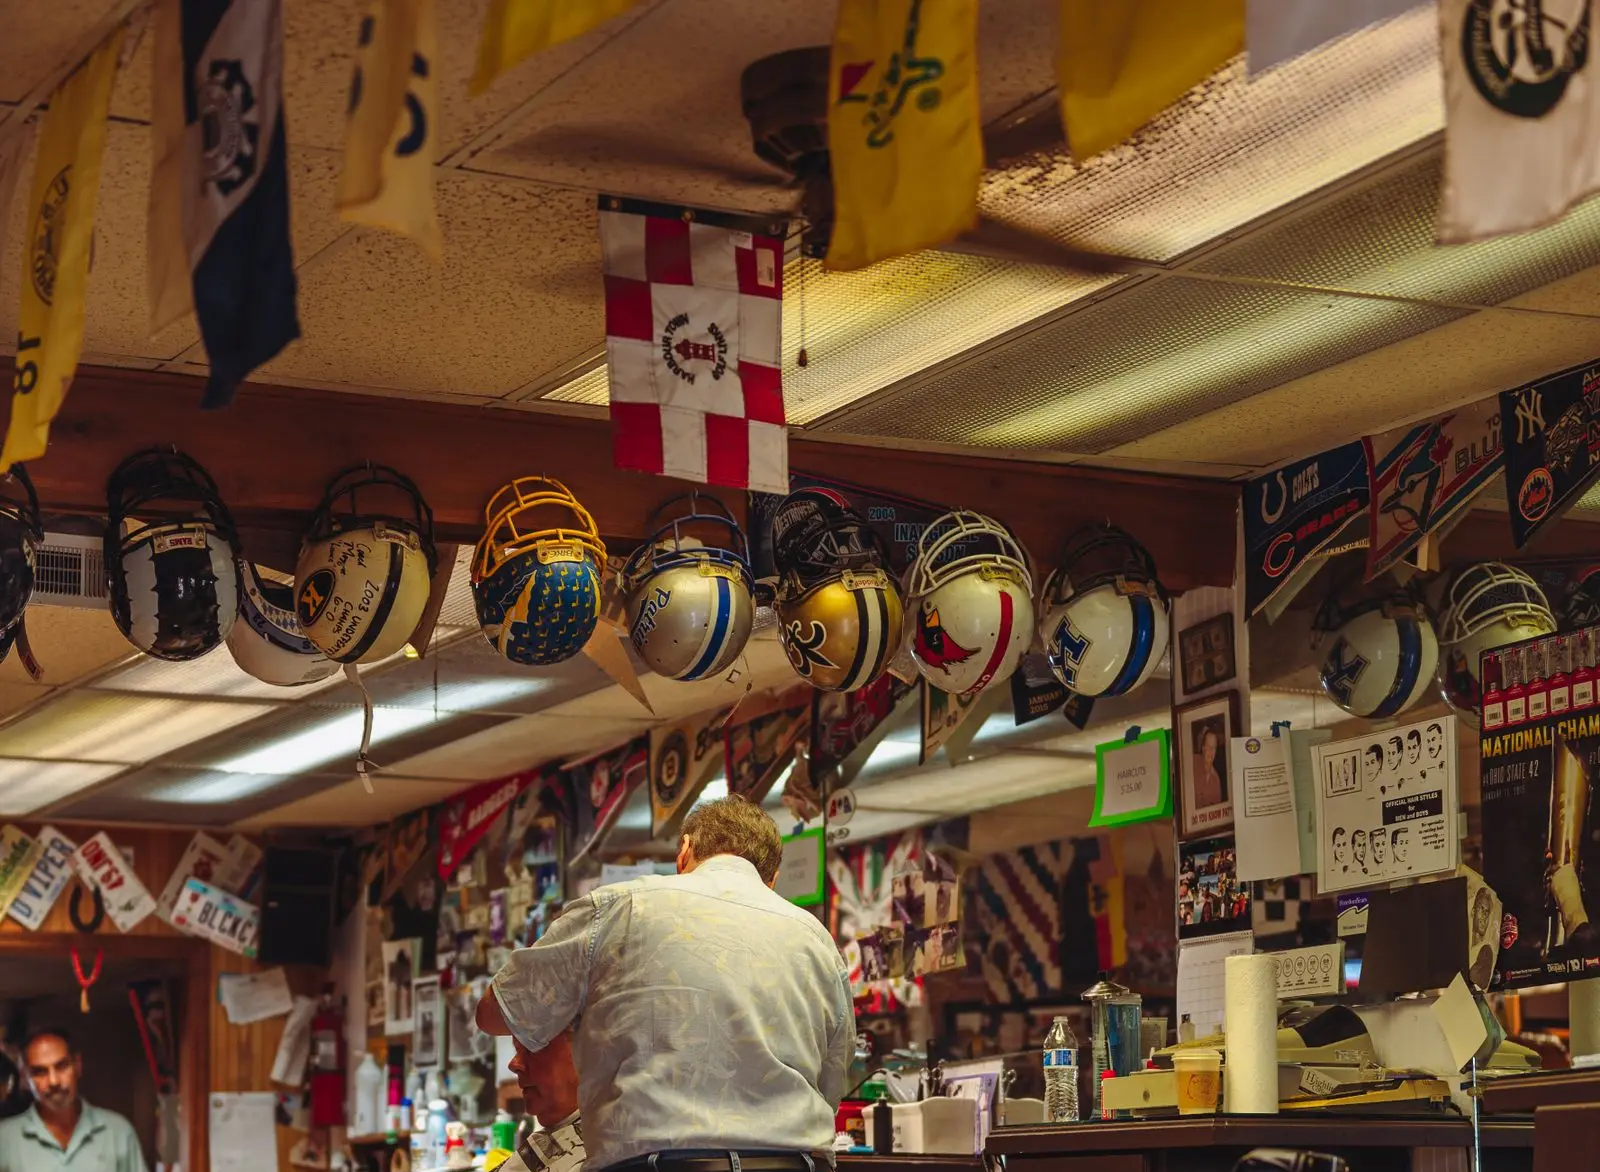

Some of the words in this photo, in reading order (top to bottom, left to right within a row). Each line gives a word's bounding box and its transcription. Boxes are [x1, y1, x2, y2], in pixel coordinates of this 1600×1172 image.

[664, 312, 690, 335] TOWN
[707, 322, 728, 355] LINKS
[662, 336, 696, 386] HARBOUR
[711, 356, 727, 381] GOLF
[1292, 461, 1320, 502] COLTS
[869, 507, 896, 521] 2004
[1296, 498, 1359, 541] BEARS
[169, 536, 194, 547] RAMS
[358, 579, 380, 613] 2003
[325, 596, 344, 622] 6-0
[332, 601, 354, 634] CHAMPS
[1482, 725, 1552, 758] NATIONAL
[1117, 766, 1147, 780] HAIRCUTS
[1506, 761, 1526, 783] STATE
[1528, 759, 1539, 778] 42
[1385, 799, 1407, 809] OFFICIAL
[1407, 795, 1419, 803] HAIR
[1420, 791, 1438, 801] STYLES
[1198, 812, 1207, 823] YOU
[1208, 809, 1221, 821] KNOW
[1395, 814, 1406, 822] MEN
[1416, 810, 1429, 818] BOYS
[27, 837, 74, 900] VIPER
